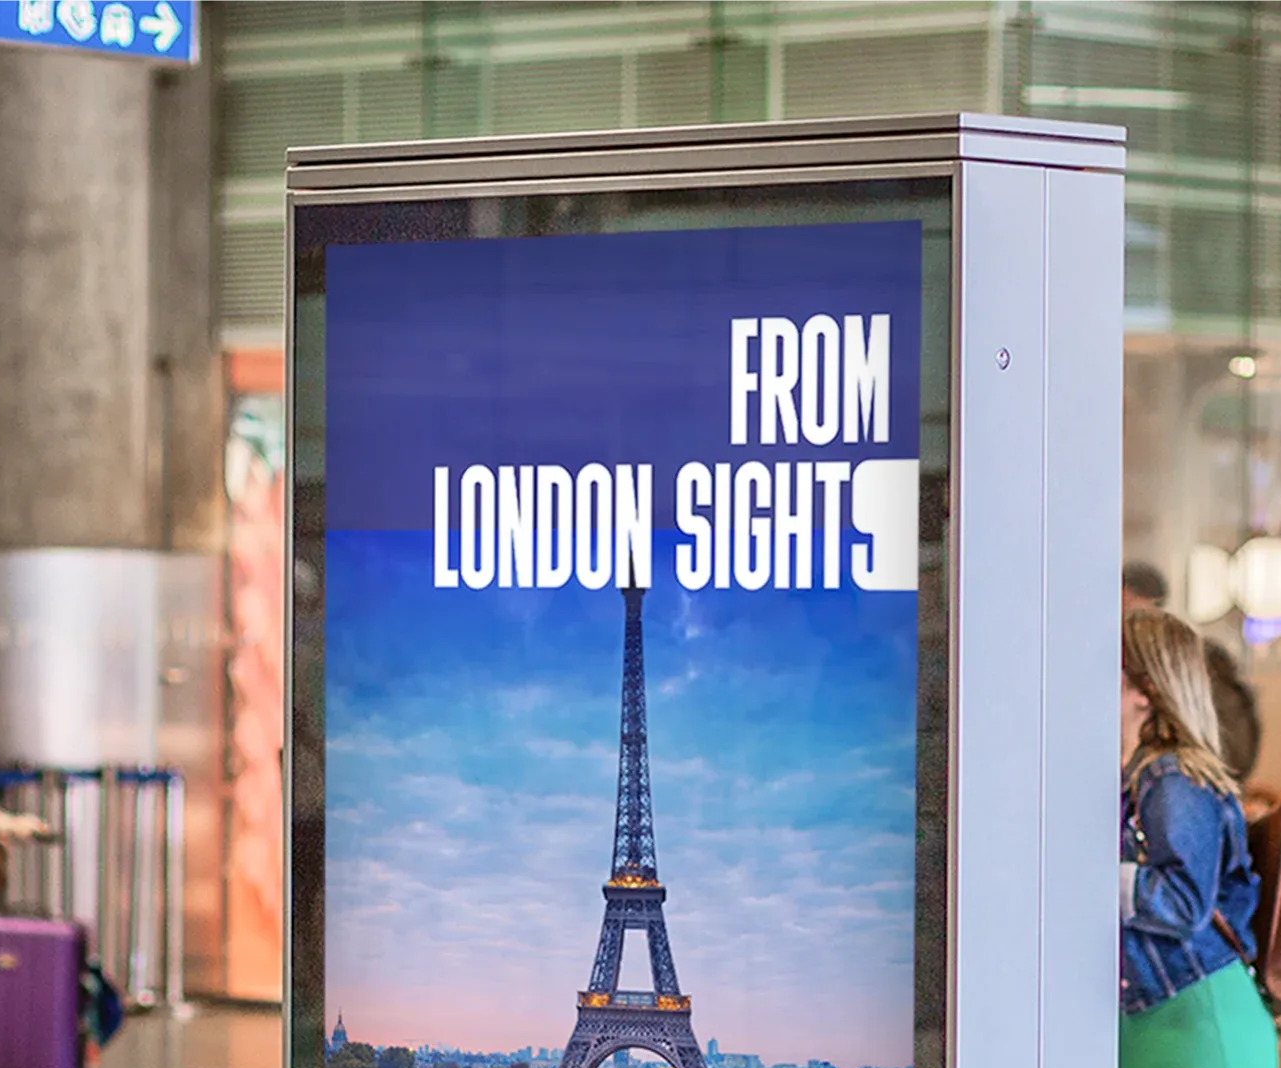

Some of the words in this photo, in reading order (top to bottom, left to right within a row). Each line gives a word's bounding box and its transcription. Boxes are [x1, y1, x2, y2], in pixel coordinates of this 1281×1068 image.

[730, 313, 891, 446] FROM
[433, 462, 653, 591] LONDON
[675, 459, 900, 591] SIGHTS
